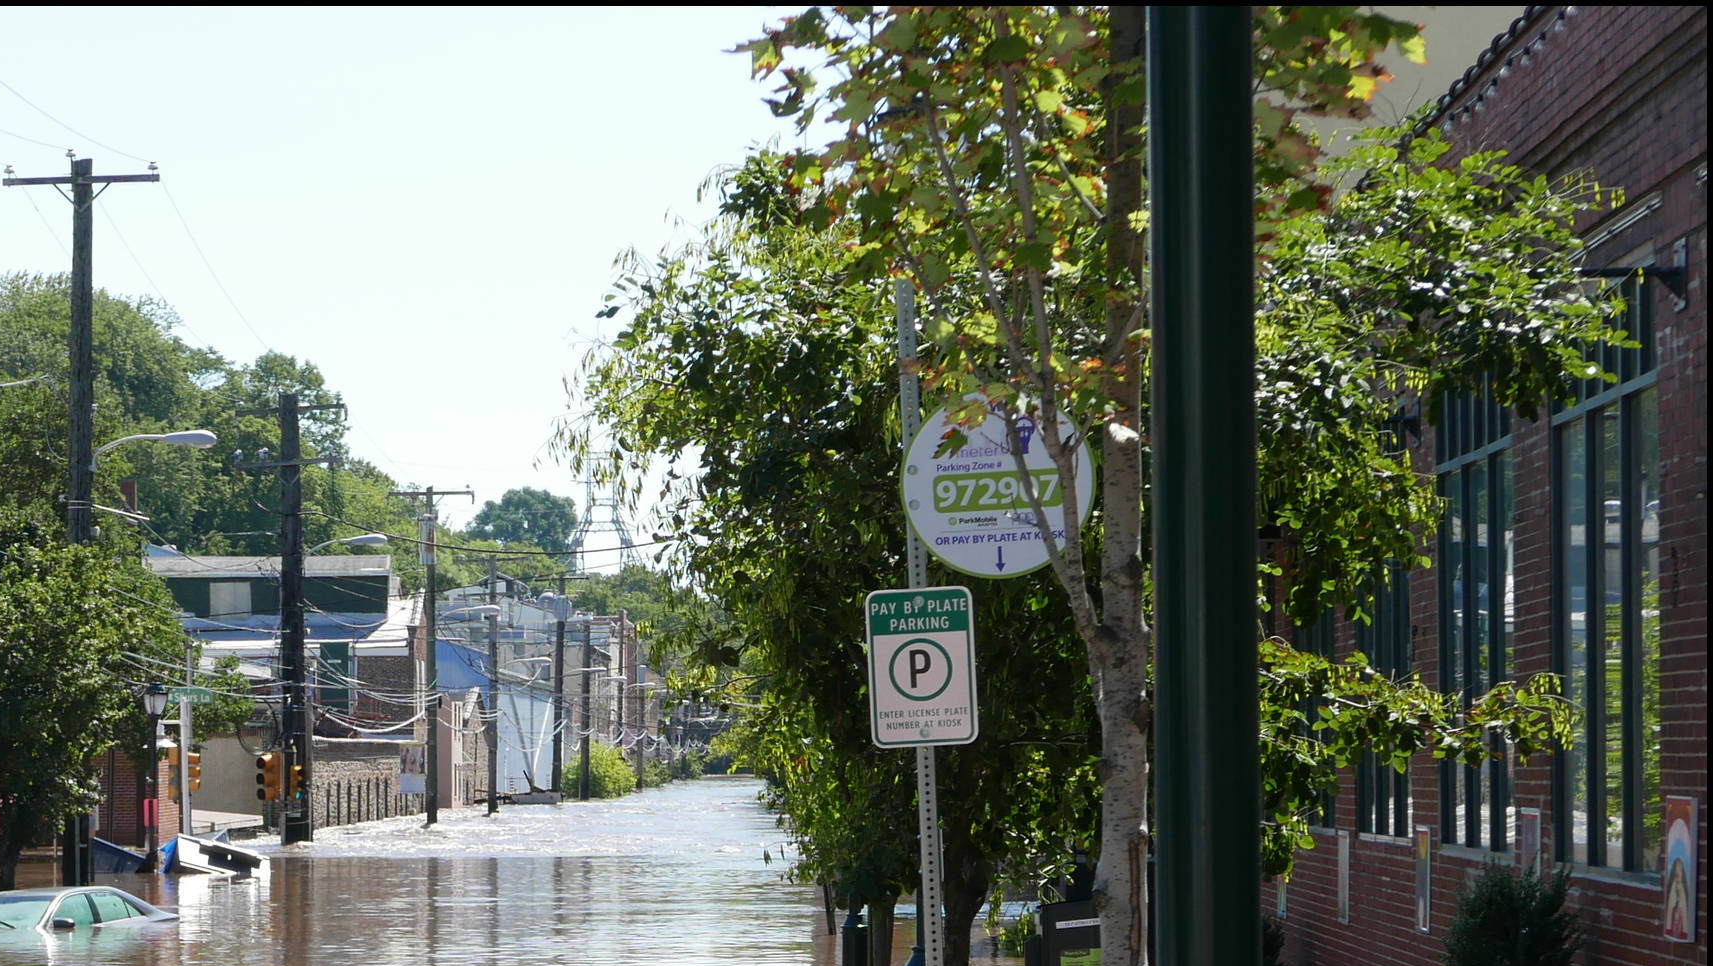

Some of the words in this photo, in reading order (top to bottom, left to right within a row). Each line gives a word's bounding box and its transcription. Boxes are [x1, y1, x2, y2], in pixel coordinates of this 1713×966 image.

[936, 463, 970, 473] Parking
[972, 462, 995, 470] Zone
[936, 474, 1060, 508] 972907
[935, 536, 950, 545] OR
[952, 536, 970, 545] PAY
[973, 534, 985, 543] BY
[985, 532, 1017, 542] PLATE
[1019, 532, 1032, 540] AT
[1034, 530, 1065, 540] KSK
[871, 602, 897, 616] PAY
[927, 598, 967, 613] PLATE
[890, 616, 950, 632] PARKING
[908, 649, 932, 689] P
[200, 694, 210, 702] La
[879, 710, 905, 720] ENTER
[908, 708, 940, 718] LICENSE
[944, 706, 969, 716] PLATE
[886, 720, 920, 730] NUMBER
[924, 720, 934, 728] AT
[938, 718, 963, 728] KIOSK
